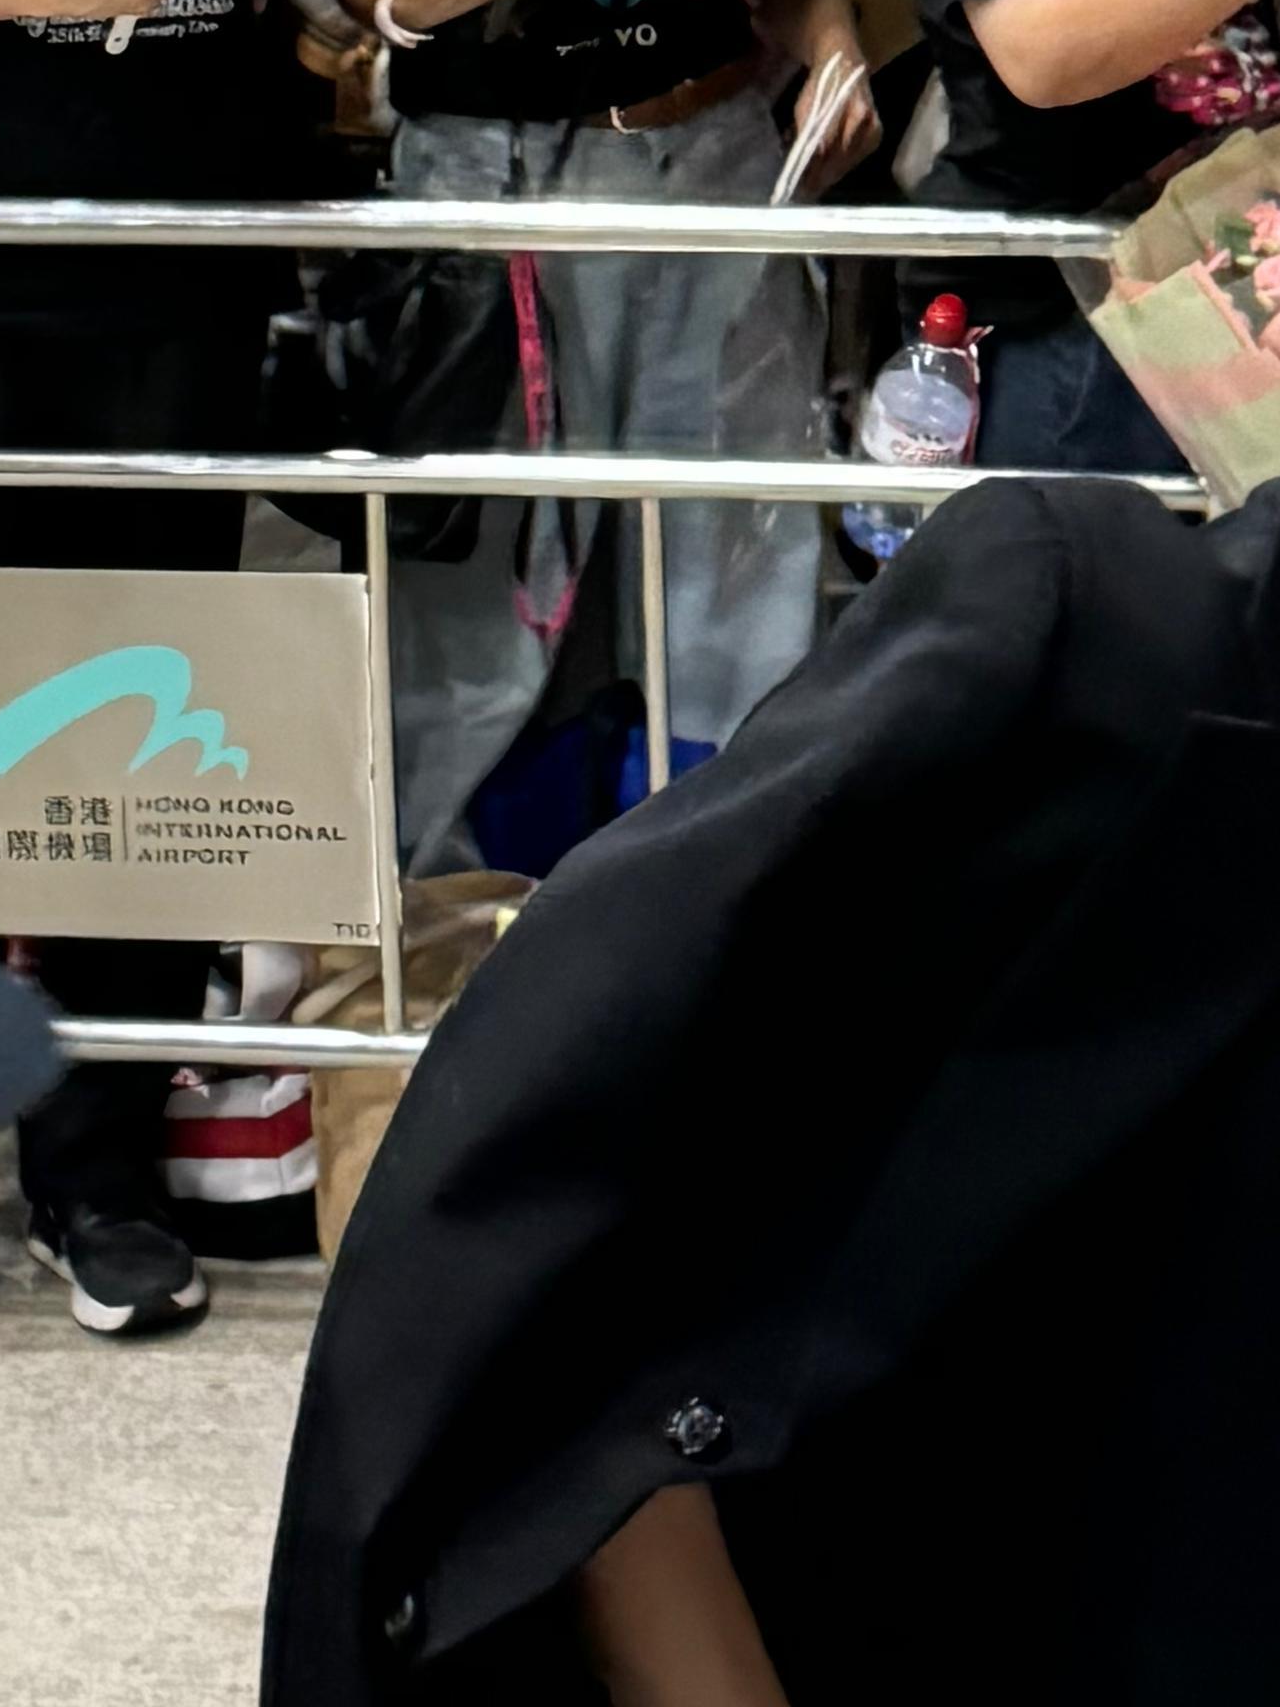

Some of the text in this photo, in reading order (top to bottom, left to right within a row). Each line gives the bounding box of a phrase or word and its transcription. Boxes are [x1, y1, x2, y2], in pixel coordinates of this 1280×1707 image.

[44, 795, 114, 827] 香港
[135, 796, 296, 817] HONG KONG
[135, 821, 348, 843] INTERNATIONAL
[136, 847, 252, 868] AIRPORT
